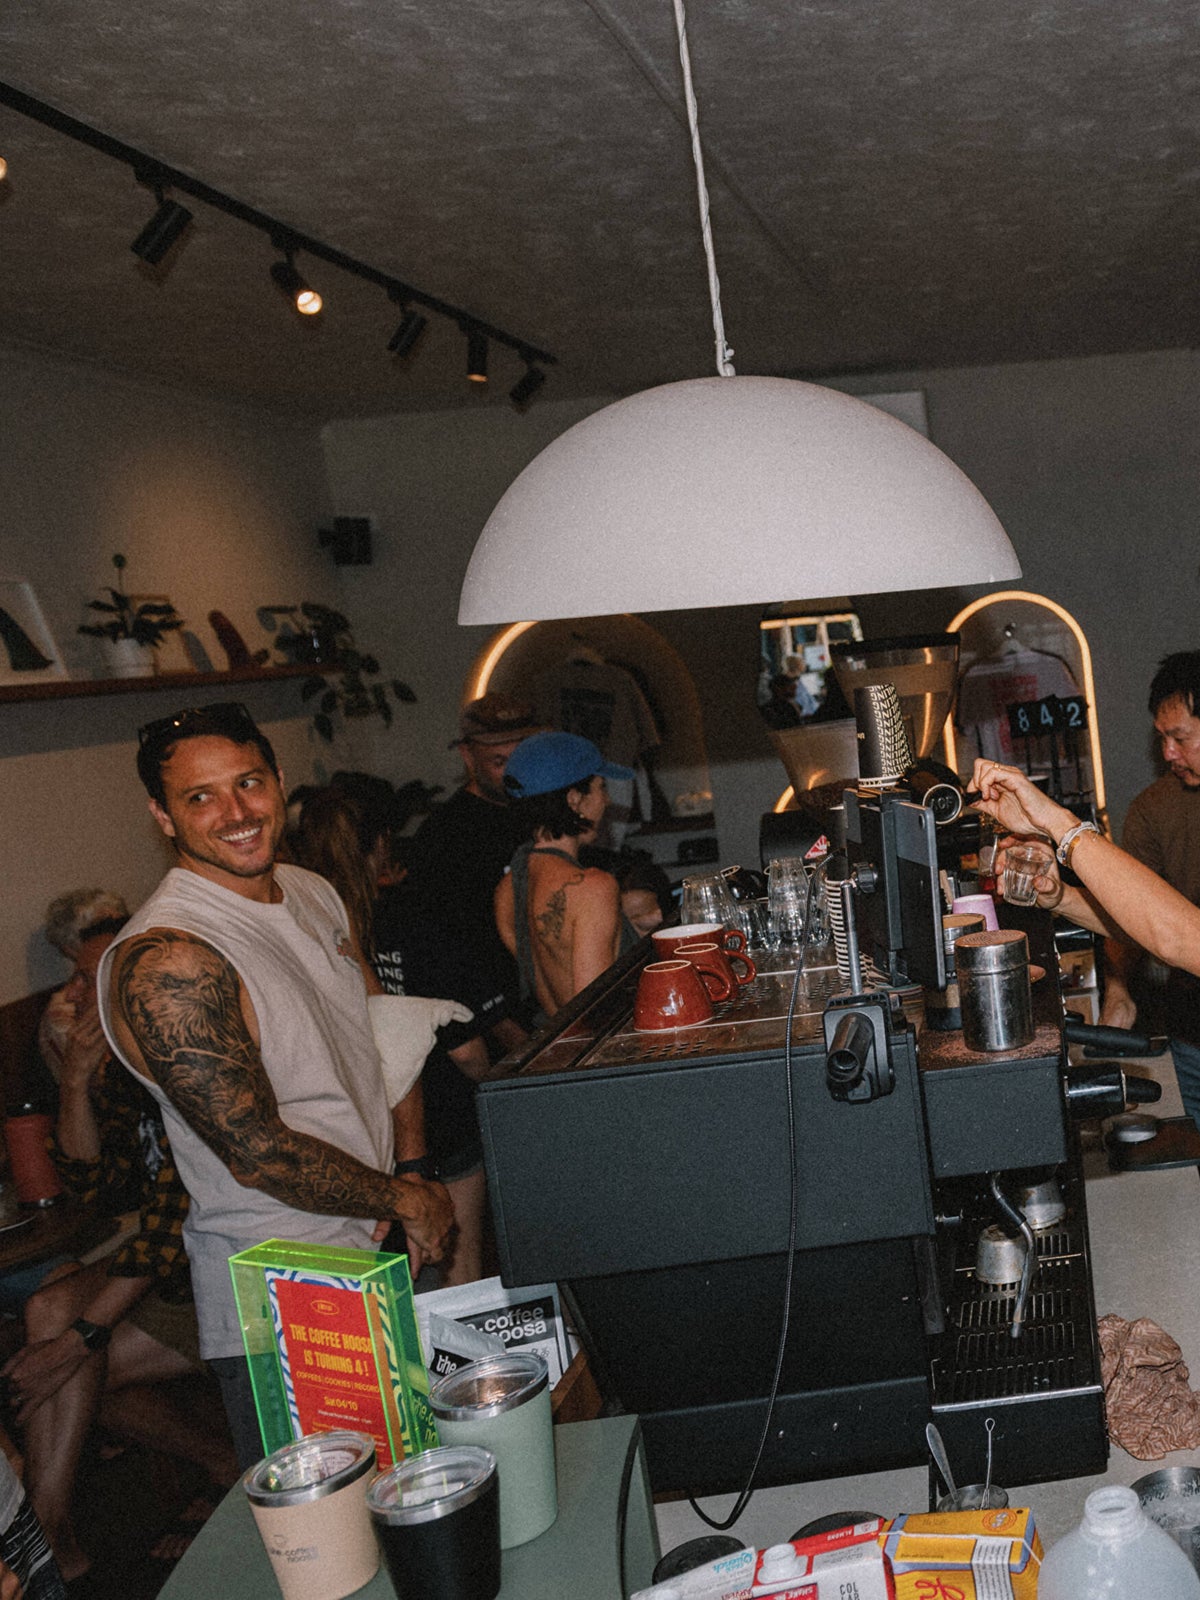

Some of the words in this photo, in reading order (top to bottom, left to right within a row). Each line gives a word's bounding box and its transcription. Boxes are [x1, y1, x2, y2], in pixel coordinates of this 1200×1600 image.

[466, 1306, 544, 1333] .coffee
[490, 1320, 547, 1343] oosa
[289, 1323, 308, 1342] THE
[308, 1327, 342, 1348] COFFEE
[304, 1349, 314, 1366] IS
[314, 1351, 354, 1374] TURNING
[827, 1529, 853, 1541] ALMOND
